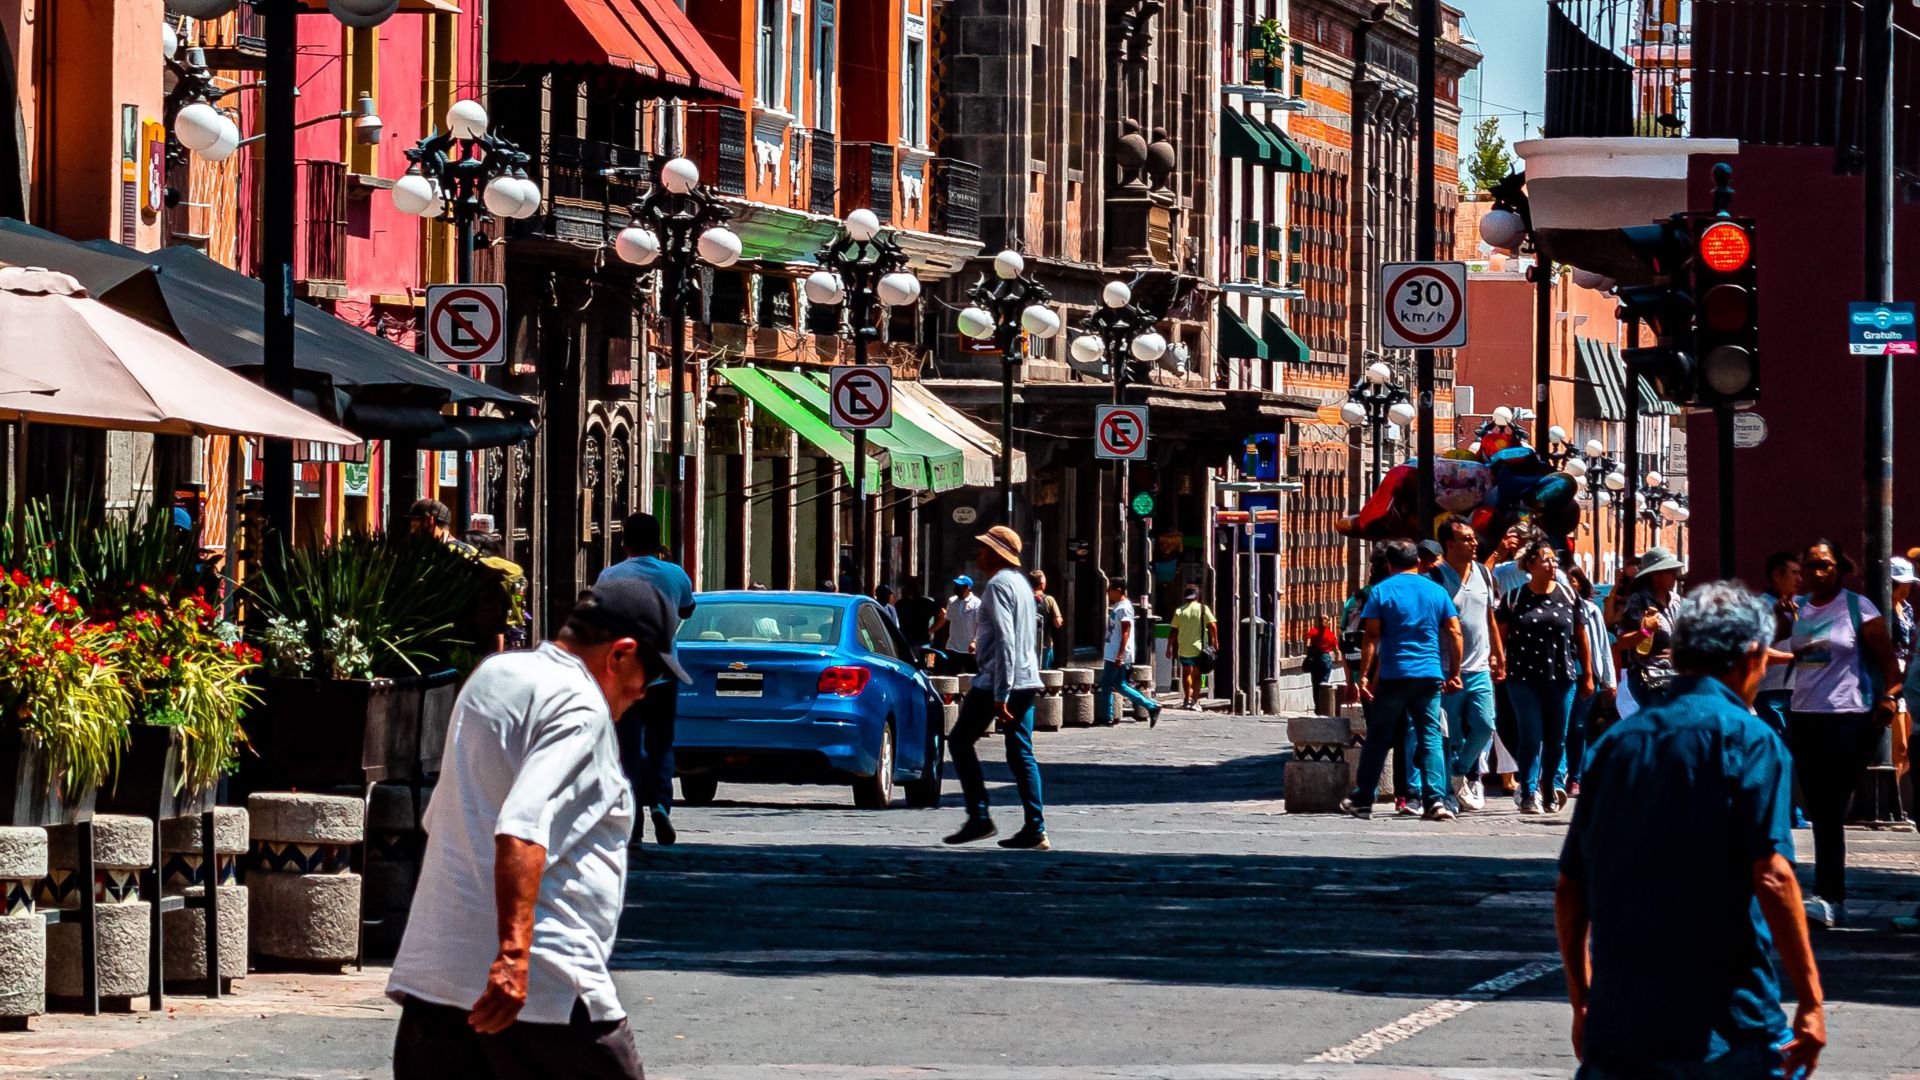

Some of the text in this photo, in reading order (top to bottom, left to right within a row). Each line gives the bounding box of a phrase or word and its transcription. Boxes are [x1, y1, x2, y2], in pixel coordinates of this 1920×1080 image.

[1405, 281, 1443, 307] 30
[450, 304, 479, 346] E
[1400, 310, 1445, 323] km/h
[1863, 330, 1902, 339] Gratuito
[850, 381, 872, 414] E
[1111, 417, 1132, 446] E
